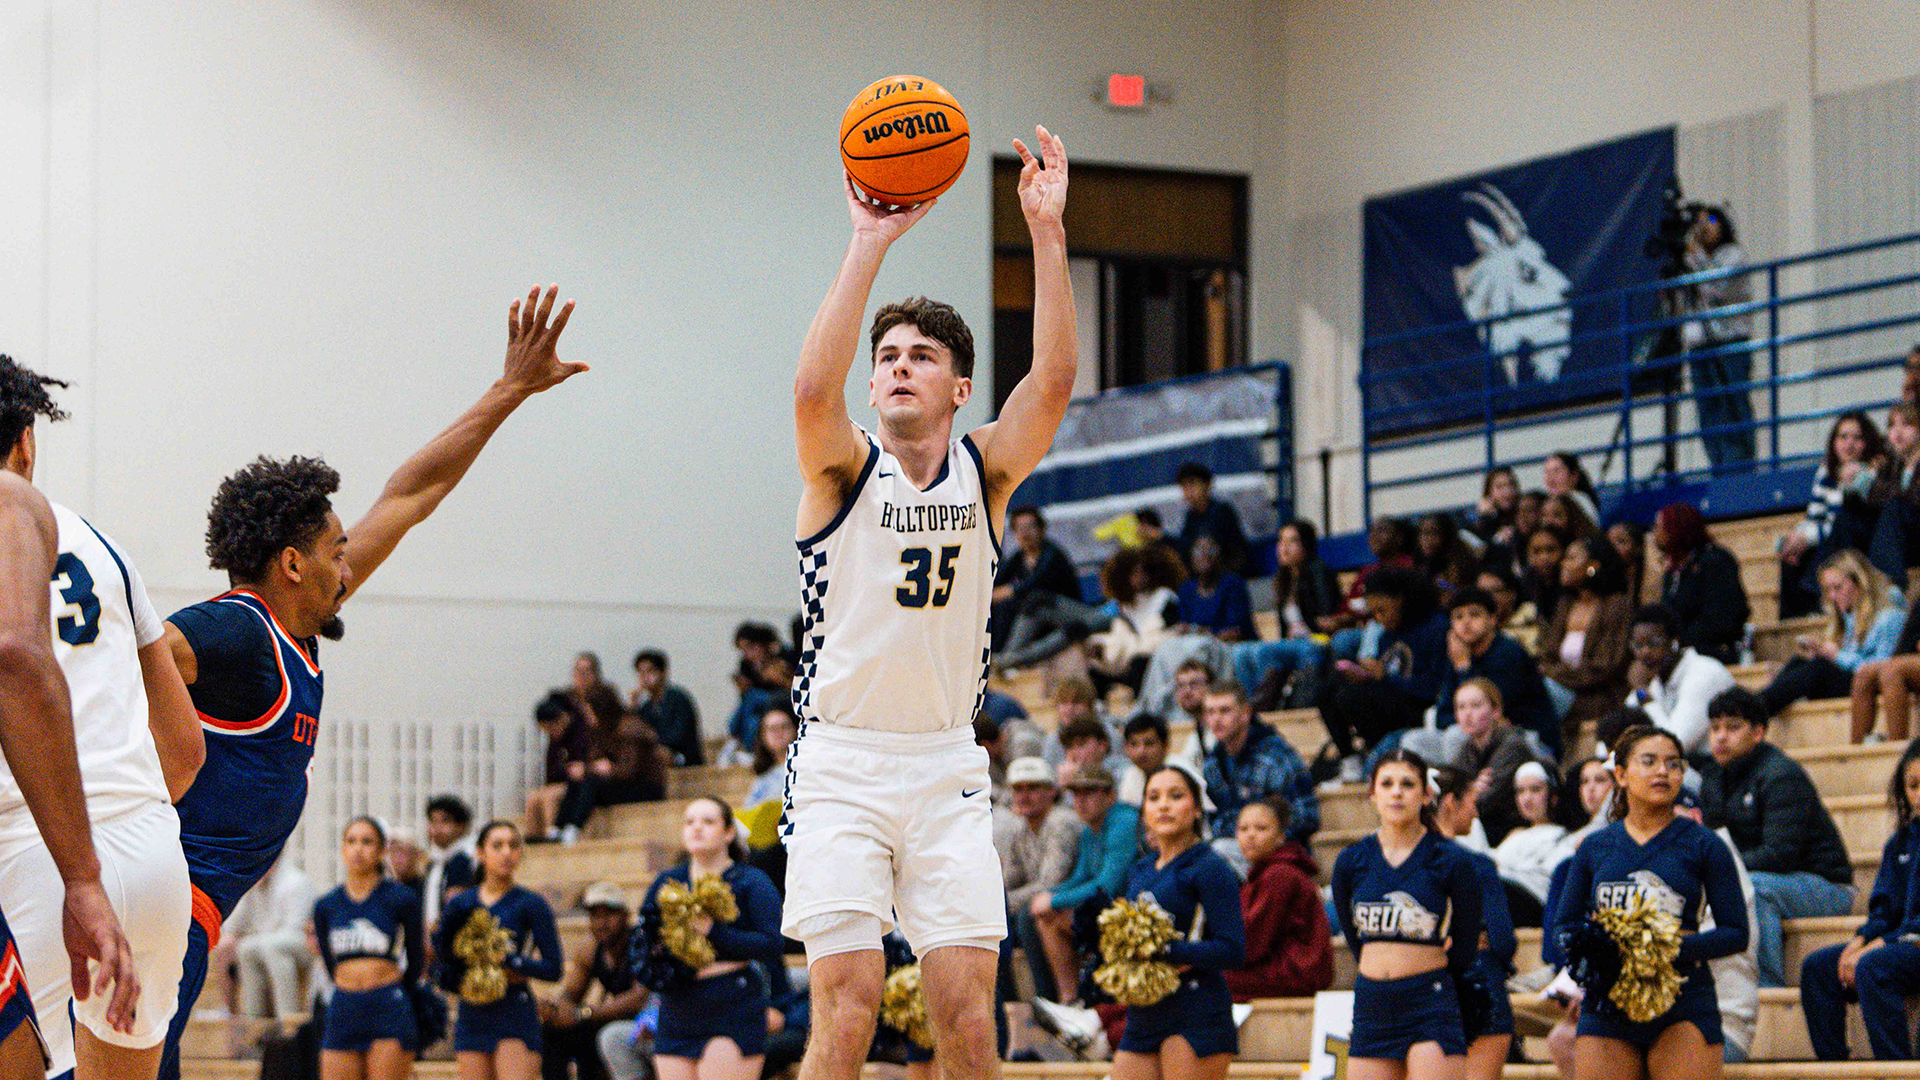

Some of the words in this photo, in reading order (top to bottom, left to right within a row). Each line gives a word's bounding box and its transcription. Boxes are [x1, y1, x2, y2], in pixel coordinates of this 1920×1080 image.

[863, 111, 951, 144] Wilson
[881, 502, 977, 532] HLLTOPPERS
[895, 543, 962, 611] 35
[51, 552, 101, 646] 3
[292, 712, 319, 746] UT
[1353, 903, 1401, 935] SEU
